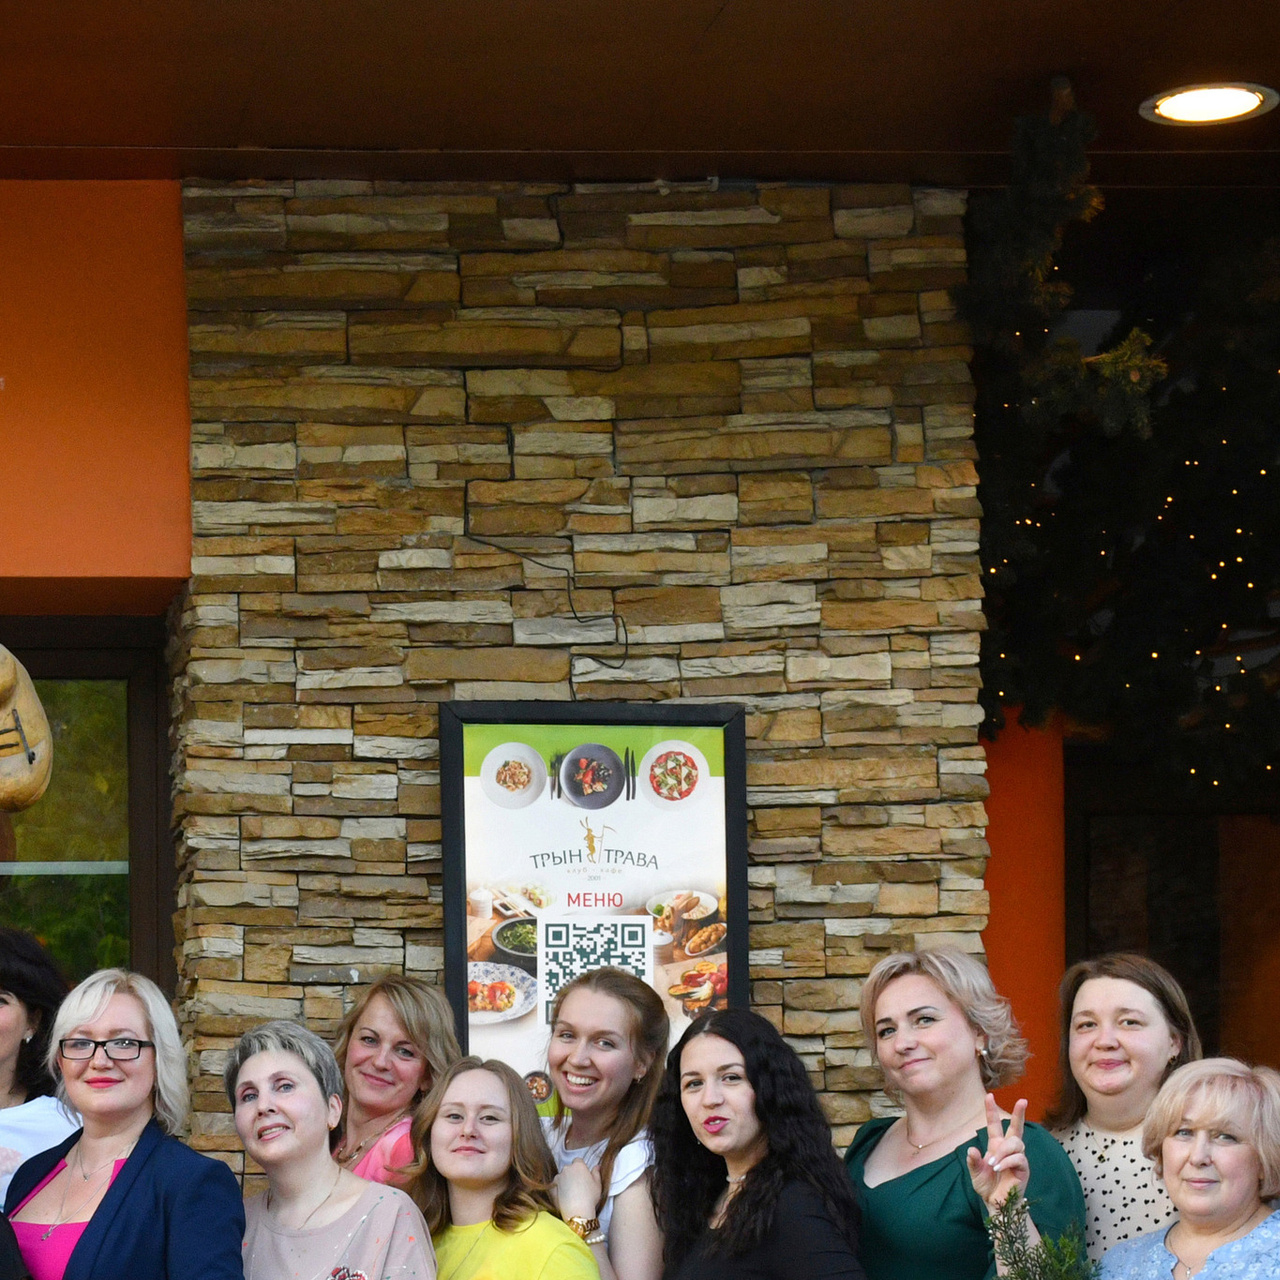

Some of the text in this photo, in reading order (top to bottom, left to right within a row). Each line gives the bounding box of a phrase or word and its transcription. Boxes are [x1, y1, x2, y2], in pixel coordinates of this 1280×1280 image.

[529, 848, 659, 870] ТРЫН ТРАВА
[567, 892, 624, 907] МЕНЮ
